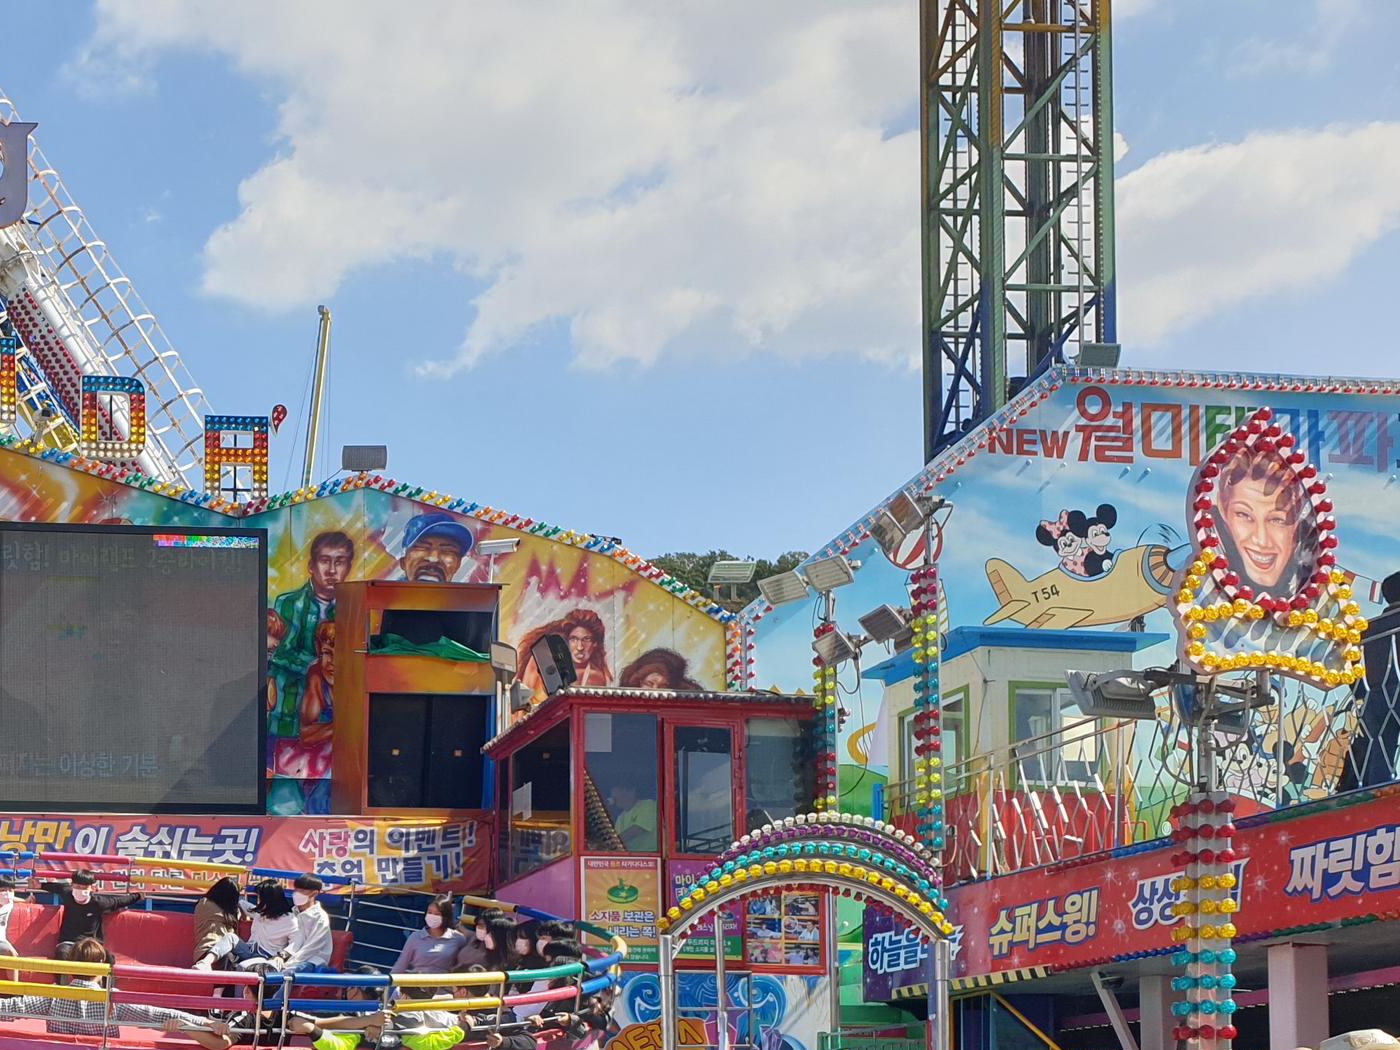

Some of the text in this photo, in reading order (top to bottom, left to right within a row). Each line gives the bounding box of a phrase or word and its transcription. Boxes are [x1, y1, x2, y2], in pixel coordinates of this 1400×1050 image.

[987, 424, 1070, 460] NEW
[1041, 584, 1060, 600] 54
[301, 820, 476, 859] 사랑의 이벤트!
[376, 852, 462, 884] 만들기!
[591, 910, 621, 922] 소지품
[989, 889, 1099, 955] 슈퍼스윙!
